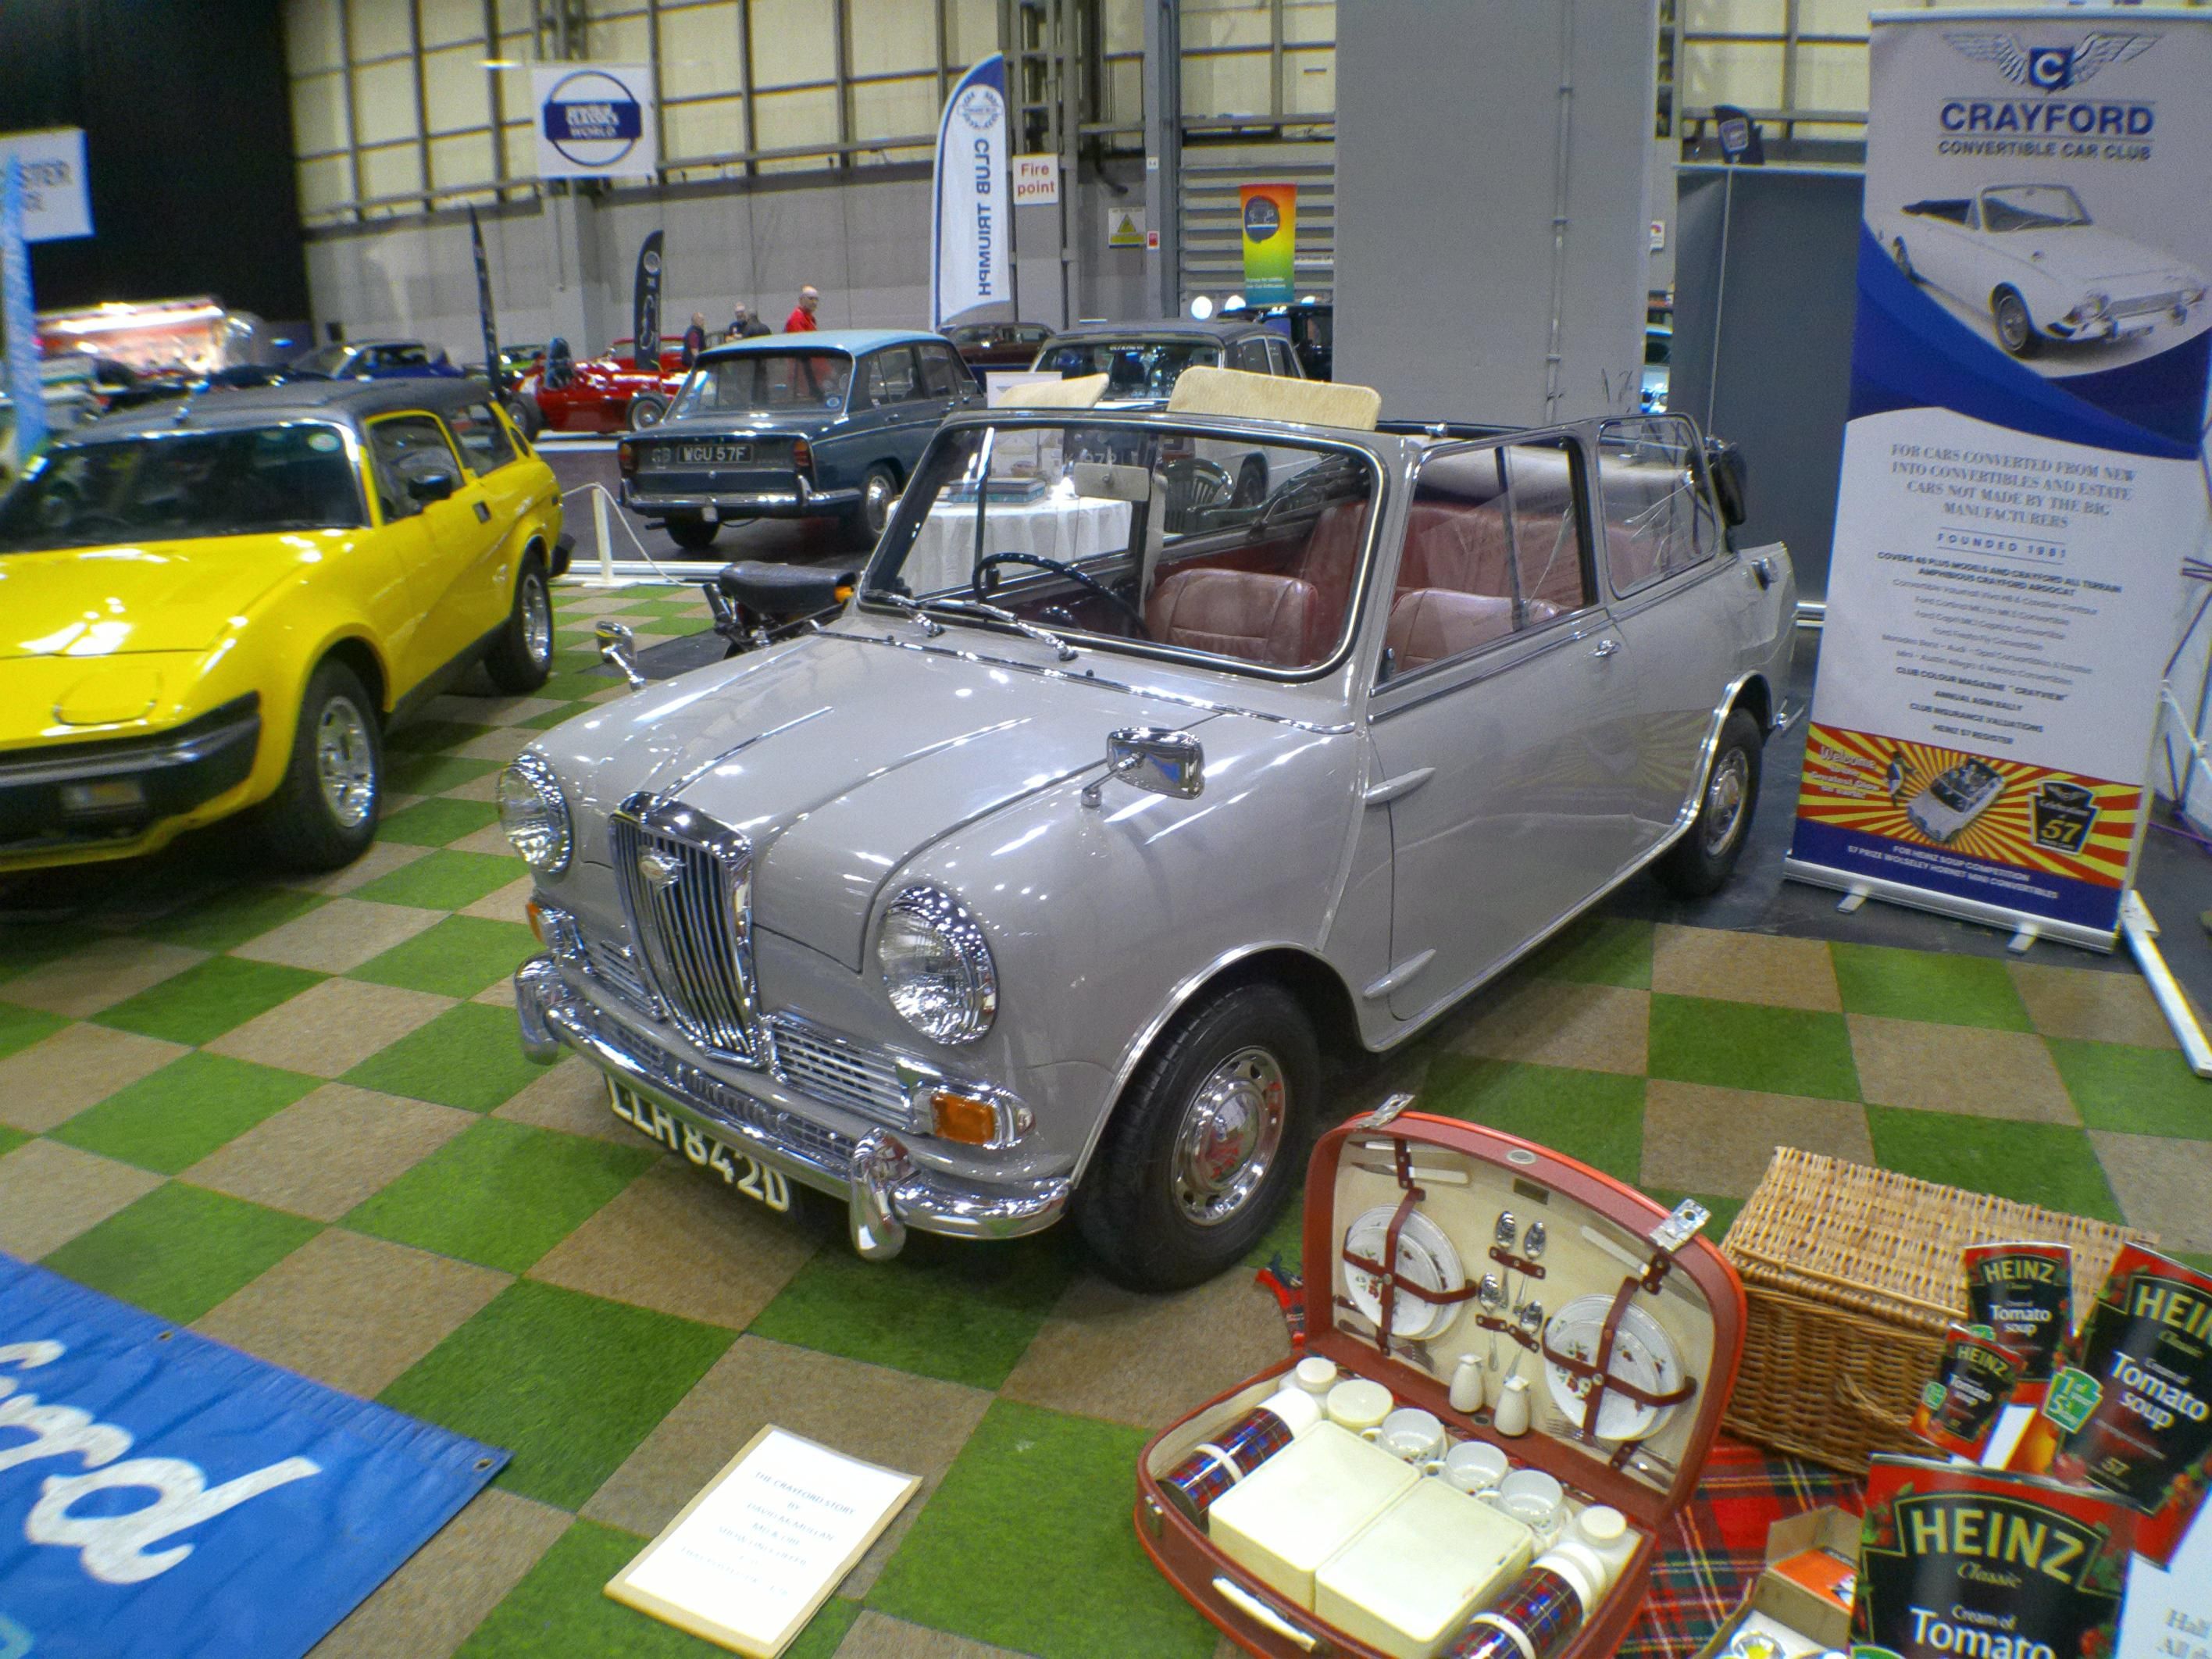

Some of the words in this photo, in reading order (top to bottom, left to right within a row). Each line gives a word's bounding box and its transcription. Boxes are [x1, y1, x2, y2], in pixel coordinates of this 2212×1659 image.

[2034, 52, 2064, 84] C
[1940, 102, 2154, 136] CRAYFORD
[1937, 140, 2056, 157] CONVERTIBLE
[2060, 143, 2098, 159] CAR
[2103, 144, 2151, 161] CLUB
[1021, 162, 1049, 177] Fire
[1017, 180, 1054, 197] point
[716, 446, 746, 461] 57F
[1891, 443, 1921, 458] FOR
[1923, 446, 1960, 462] CARS
[1963, 449, 2053, 473] CONVERTED
[2053, 460, 2100, 477] FROM
[2103, 466, 2137, 481] NEW
[1892, 461, 1928, 476] INTO
[1930, 465, 2041, 488] CONVERTIBLES
[2043, 478, 2075, 494] AND
[2077, 481, 2132, 501] ESTATE
[1907, 480, 1945, 495] CARS
[1948, 483, 1977, 499] NOT
[1981, 487, 2021, 505] MADE
[2025, 494, 2044, 508] BY
[2049, 496, 2081, 512] THE
[2082, 501, 2111, 516] BIG
[1943, 501, 2069, 530] MANUFACTURERS
[1938, 533, 2018, 551] FOUNDED
[1819, 745, 1876, 770] Welcome
[2042, 819, 2082, 843] 57
[601, 1071, 678, 1151] LLH
[683, 1122, 790, 1212] 842D
[1983, 1259, 2056, 1283] HEINZ
[1989, 1304, 2053, 1322] Tomato
[2003, 1322, 2038, 1337] soup
[1956, 1343, 2009, 1378] HEINZ
[2110, 1349, 2210, 1422] Tomato
[2118, 1390, 2175, 1431] soup
[773, 1479, 825, 1504] CRAYFORD
[1909, 1507, 2085, 1585] HEINZ
[1950, 1603, 1999, 1628] Cream
[1907, 1604, 2057, 1659] Tomato
